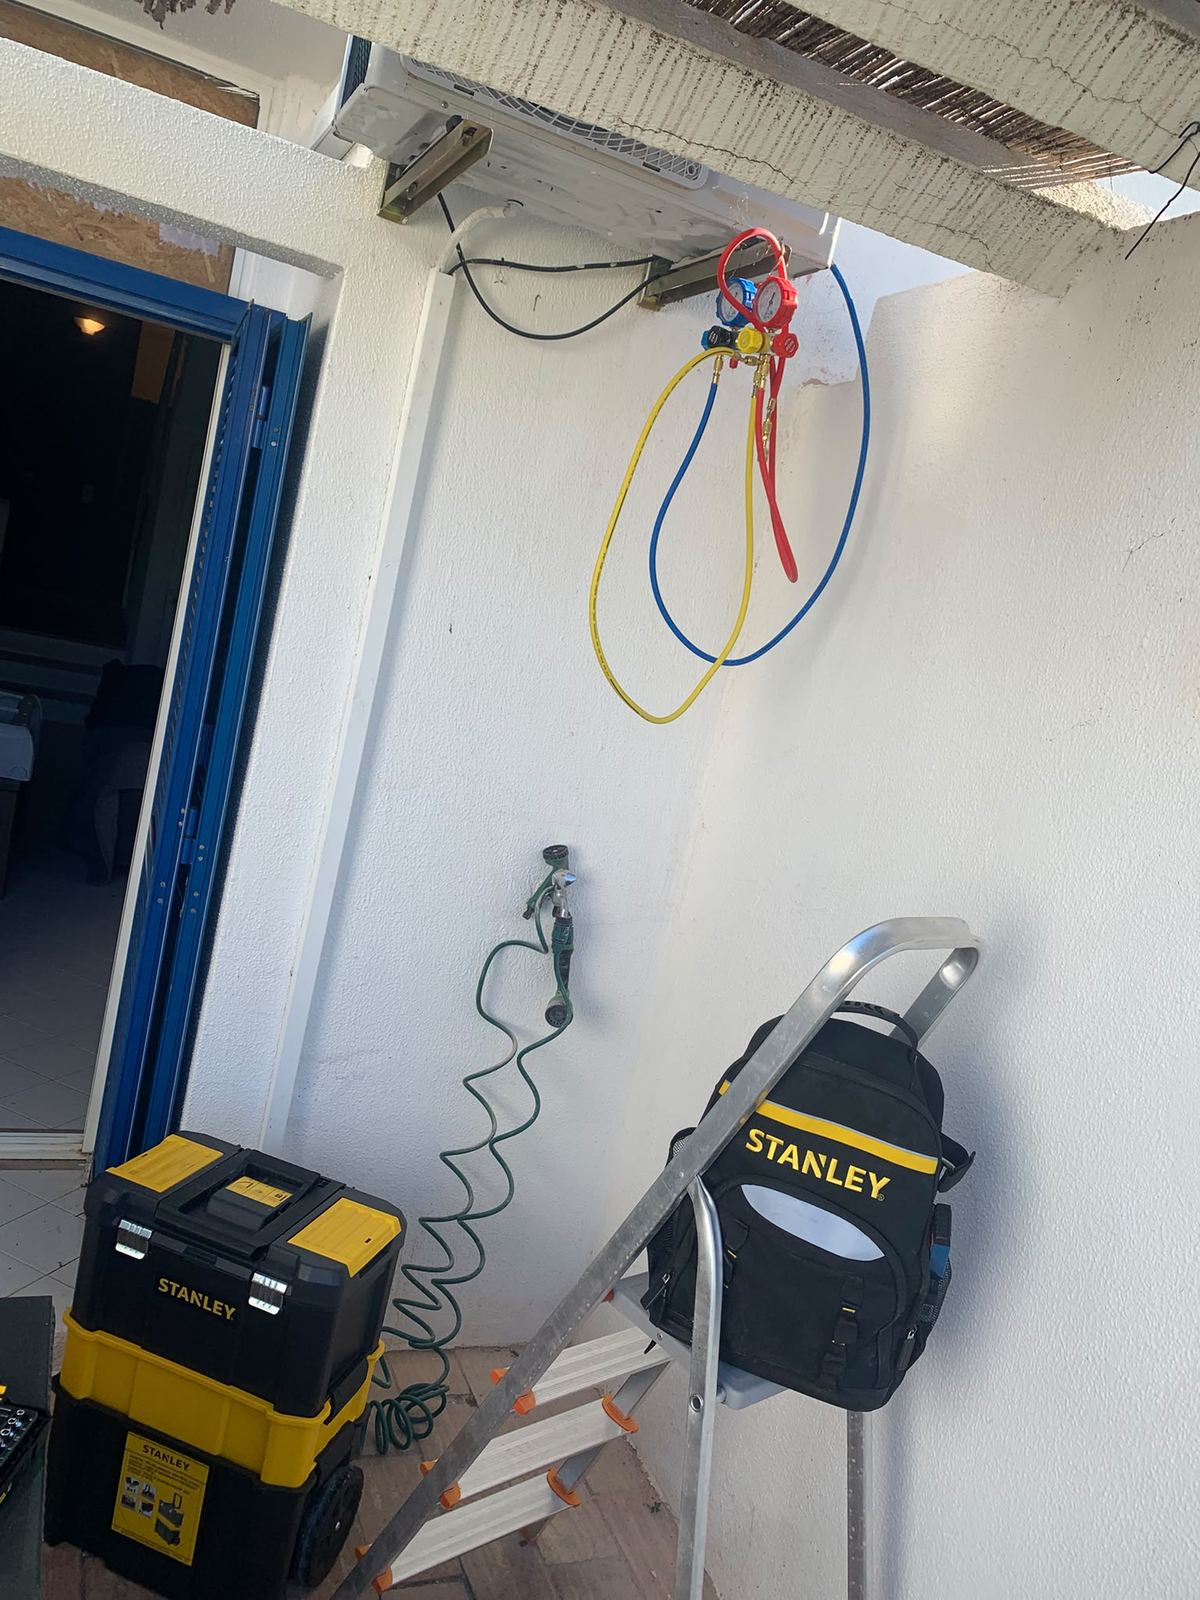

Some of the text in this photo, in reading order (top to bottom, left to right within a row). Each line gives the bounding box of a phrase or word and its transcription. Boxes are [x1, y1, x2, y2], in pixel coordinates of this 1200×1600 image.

[745, 1128, 891, 1199] STANLEY
[158, 1278, 236, 1320] STANLEY
[143, 1444, 190, 1471] STANLEY
